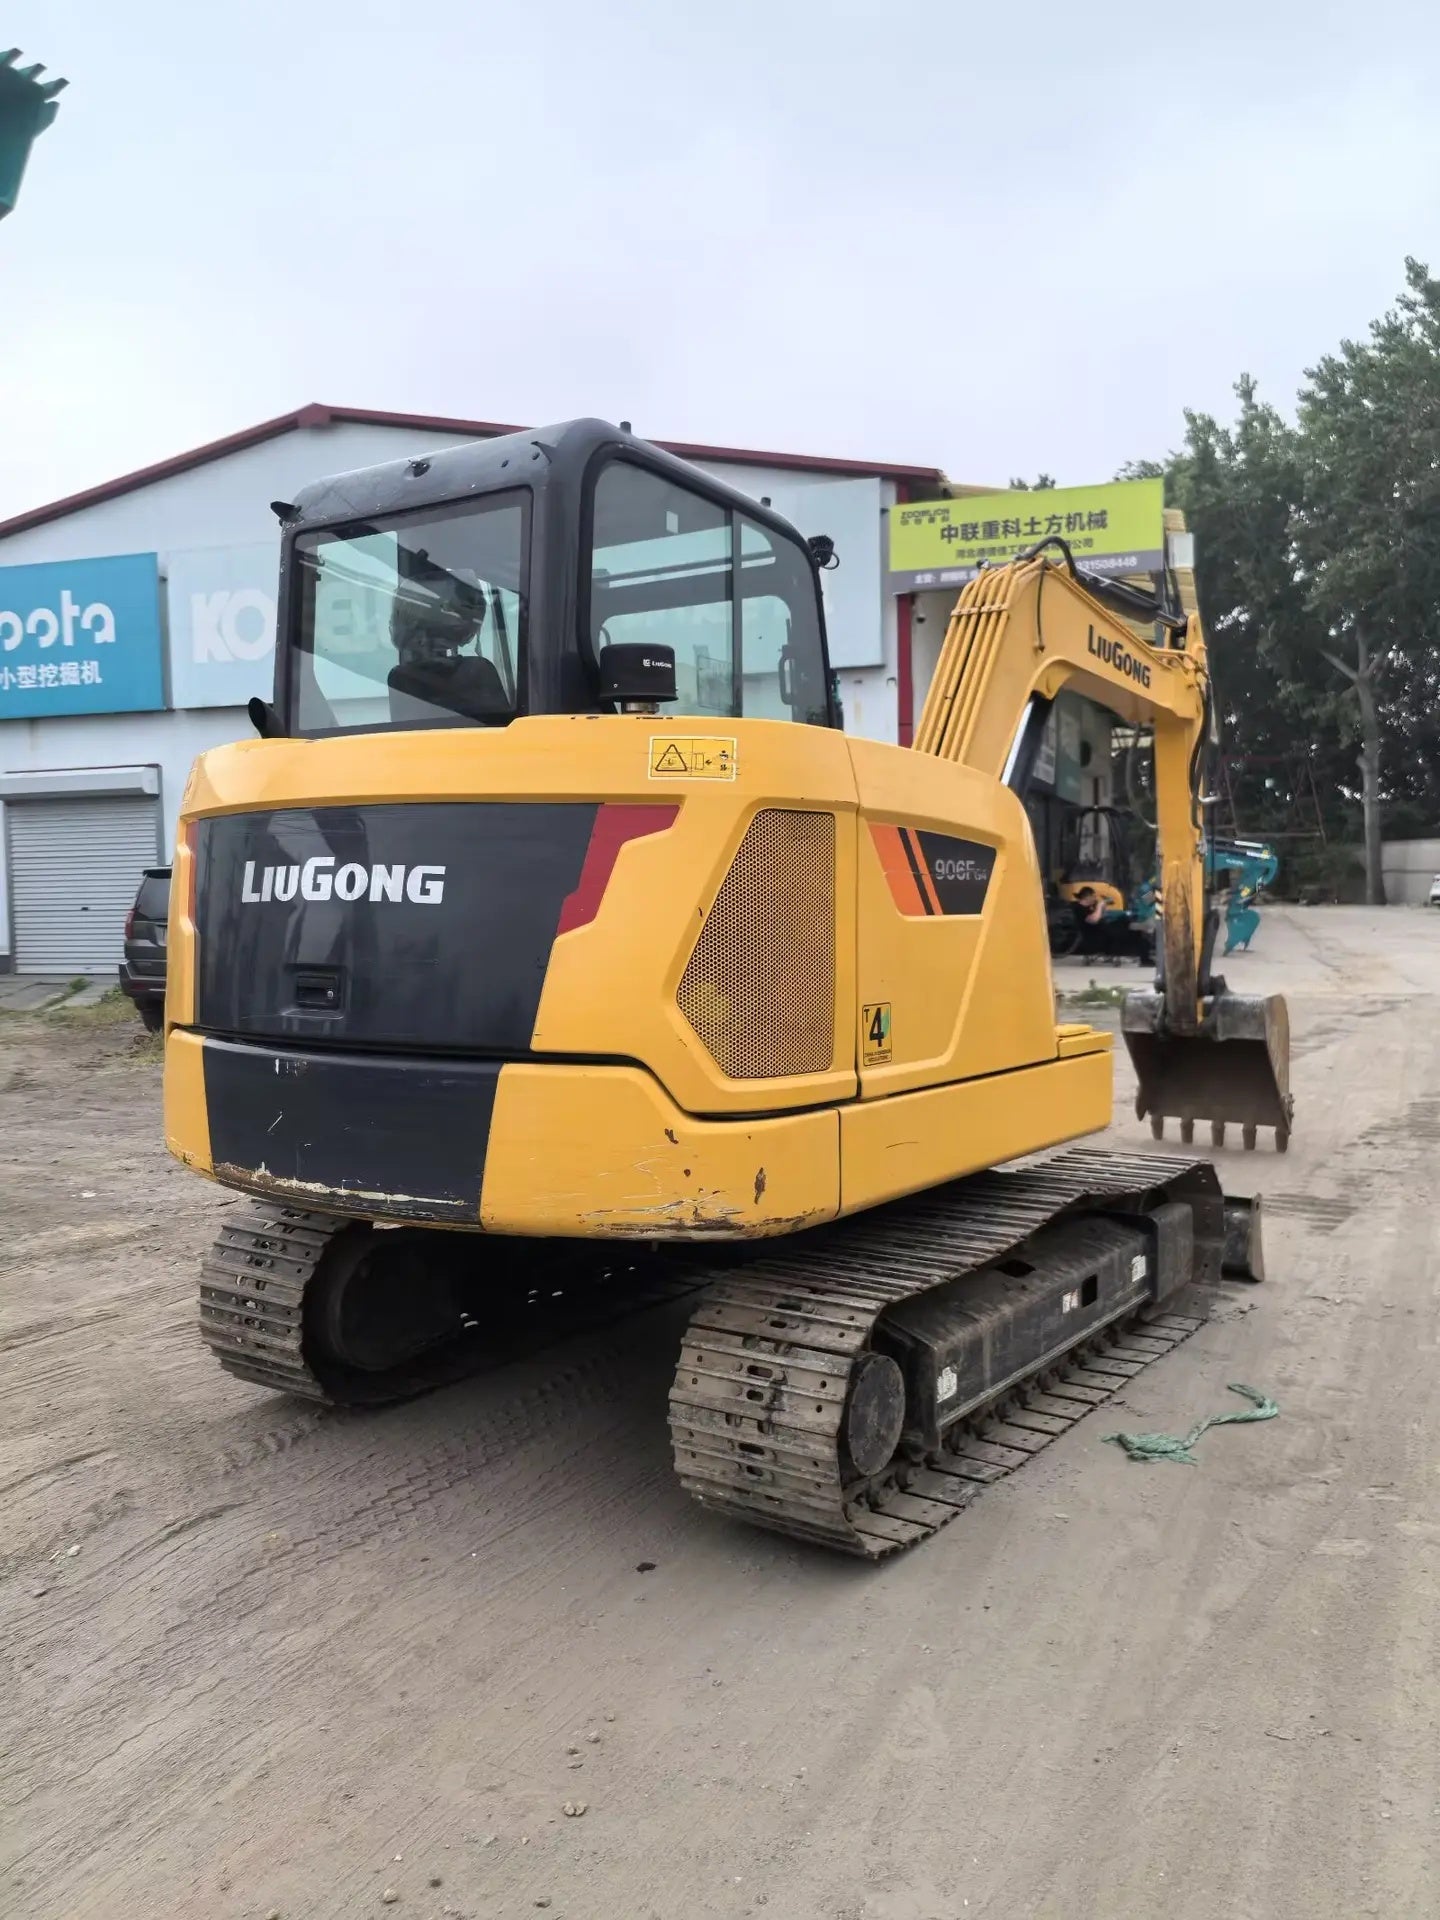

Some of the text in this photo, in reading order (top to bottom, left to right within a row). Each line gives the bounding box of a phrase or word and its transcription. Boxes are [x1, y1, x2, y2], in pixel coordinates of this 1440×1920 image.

[940, 509, 1108, 545] 中联重科土方机械
[0, 660, 103, 690] 小型挖掘机
